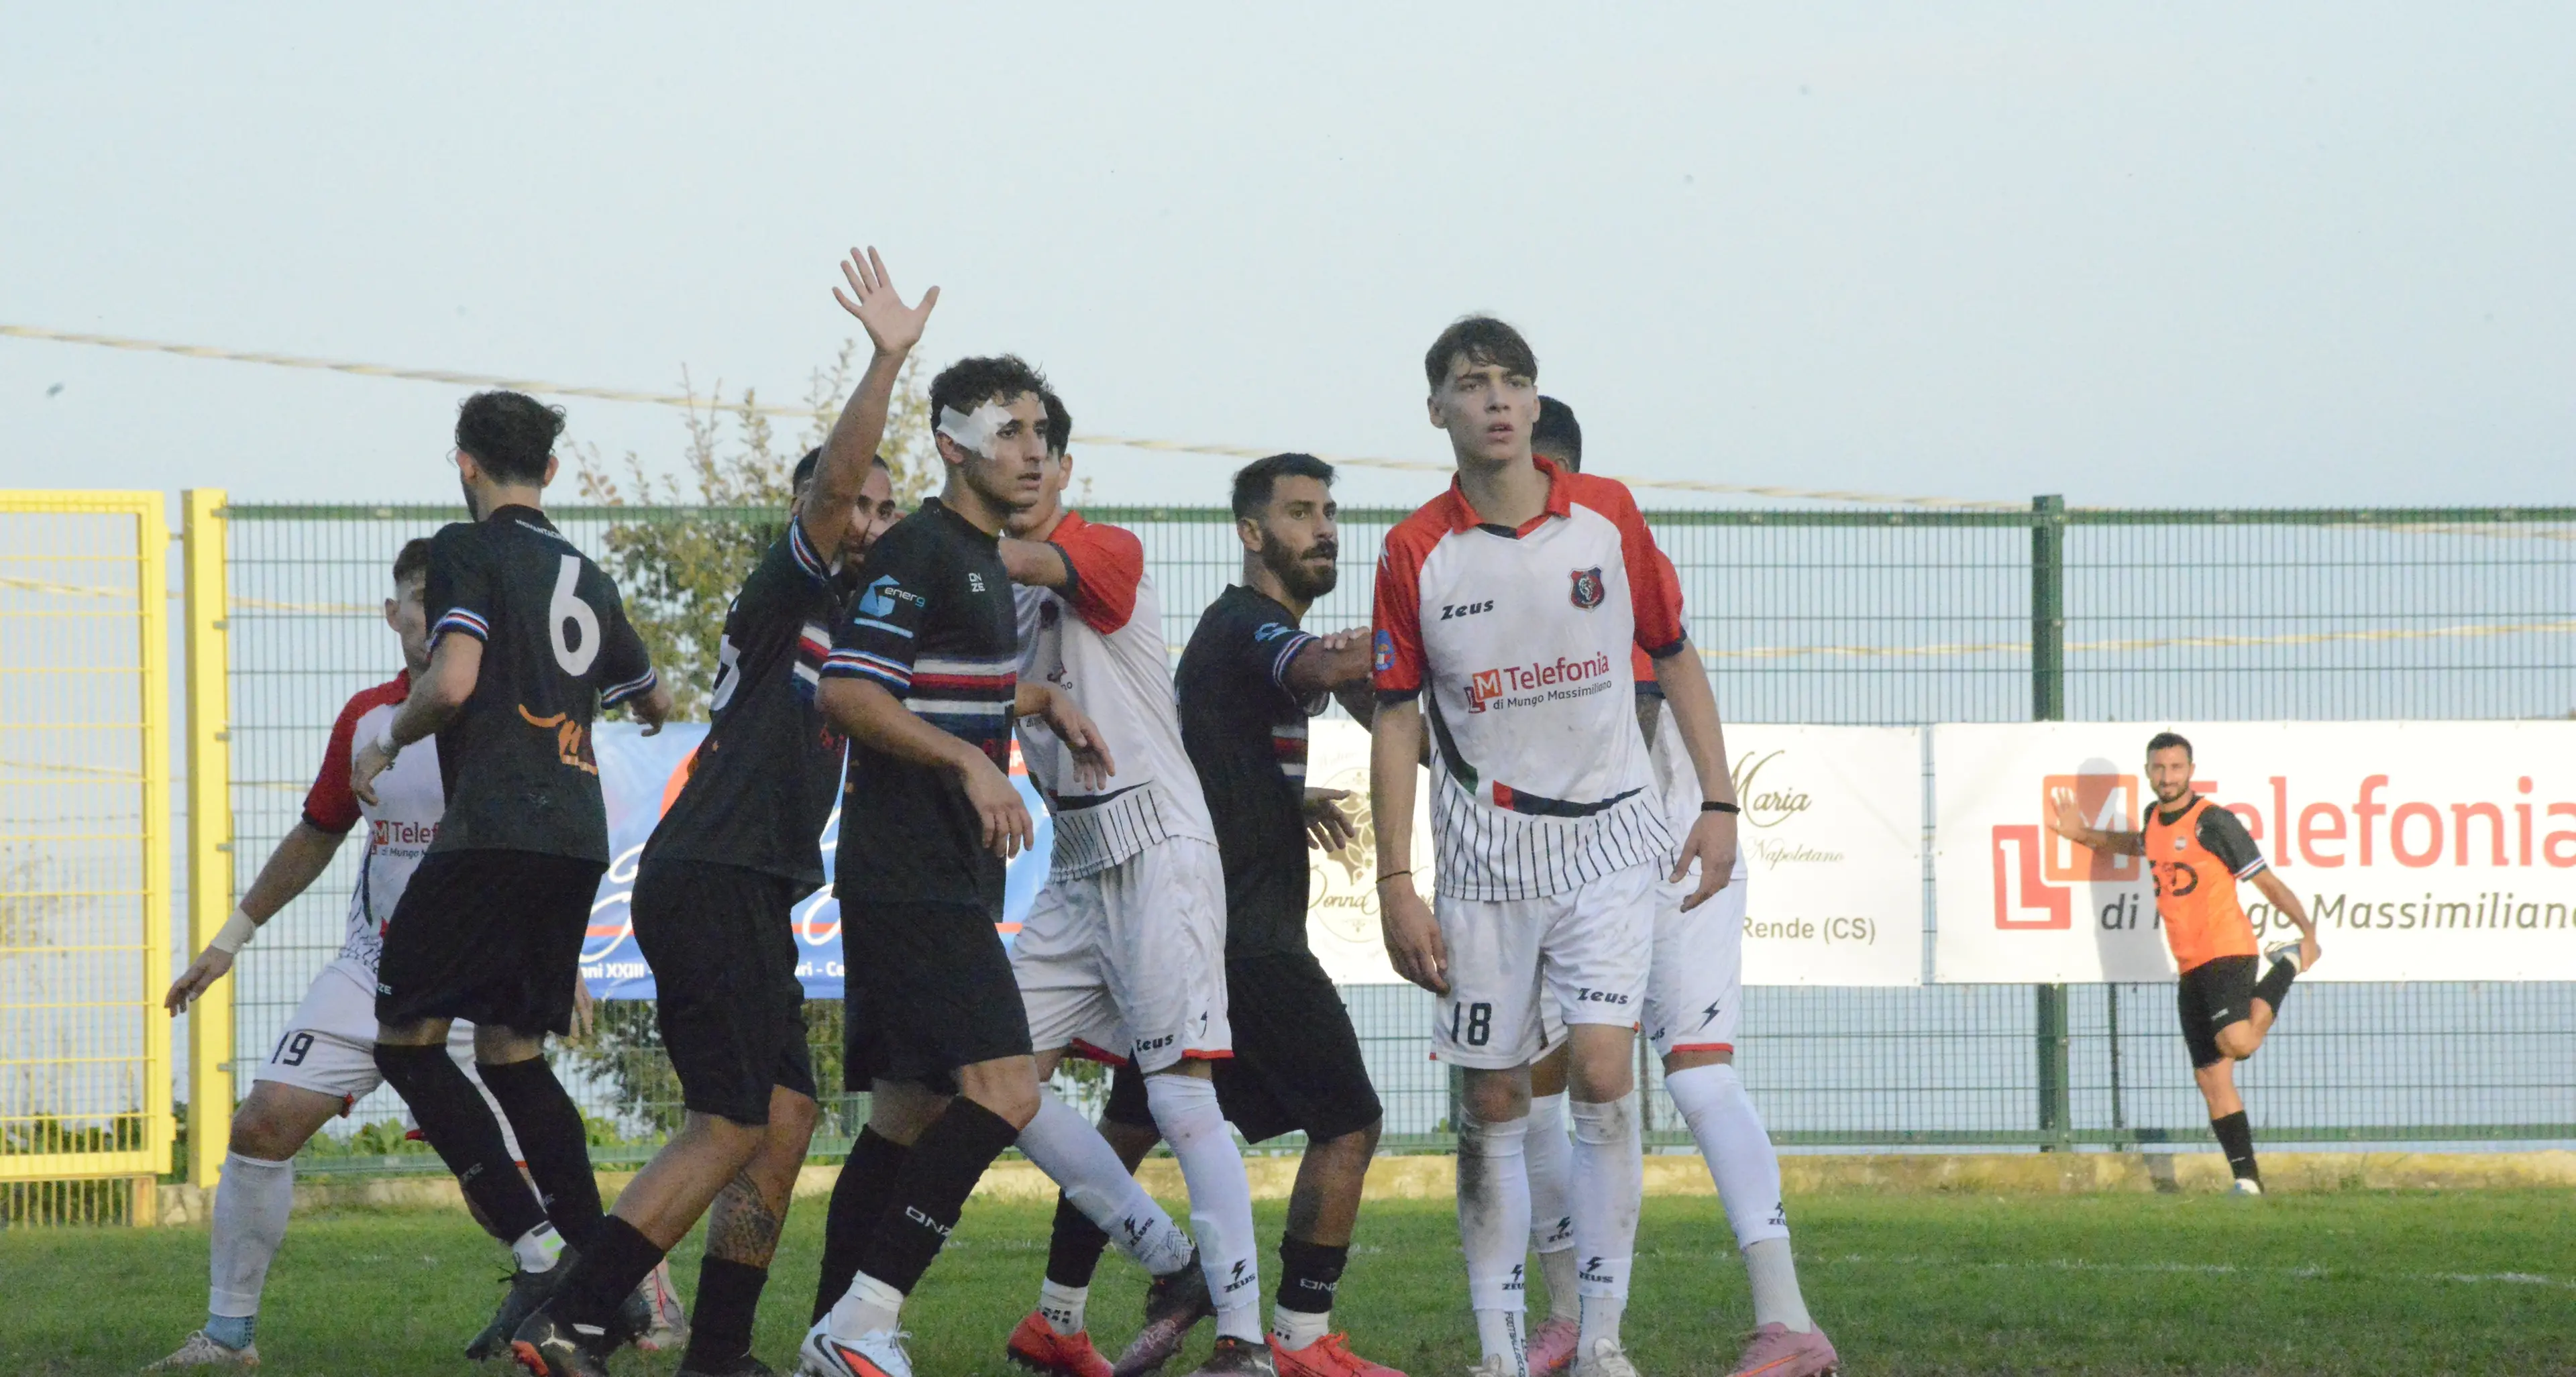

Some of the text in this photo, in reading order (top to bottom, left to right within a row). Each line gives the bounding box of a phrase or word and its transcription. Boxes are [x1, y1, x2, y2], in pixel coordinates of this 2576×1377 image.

[549, 554, 601, 677] 6
[1440, 600, 1494, 620] Zeus
[1503, 651, 1610, 691] Telefonia
[1493, 679, 1612, 710] di Mungo Massimiliano
[1731, 749, 1813, 828] Maria
[2101, 893, 2139, 930] di
[2312, 892, 2576, 930] Massimilian
[1743, 916, 1876, 946] Rende (CS)
[1577, 987, 1629, 1005] Zeus
[1452, 1001, 1492, 1046] 18
[272, 1032, 314, 1066] 19
[1223, 1273, 1256, 1293] ZEUS
